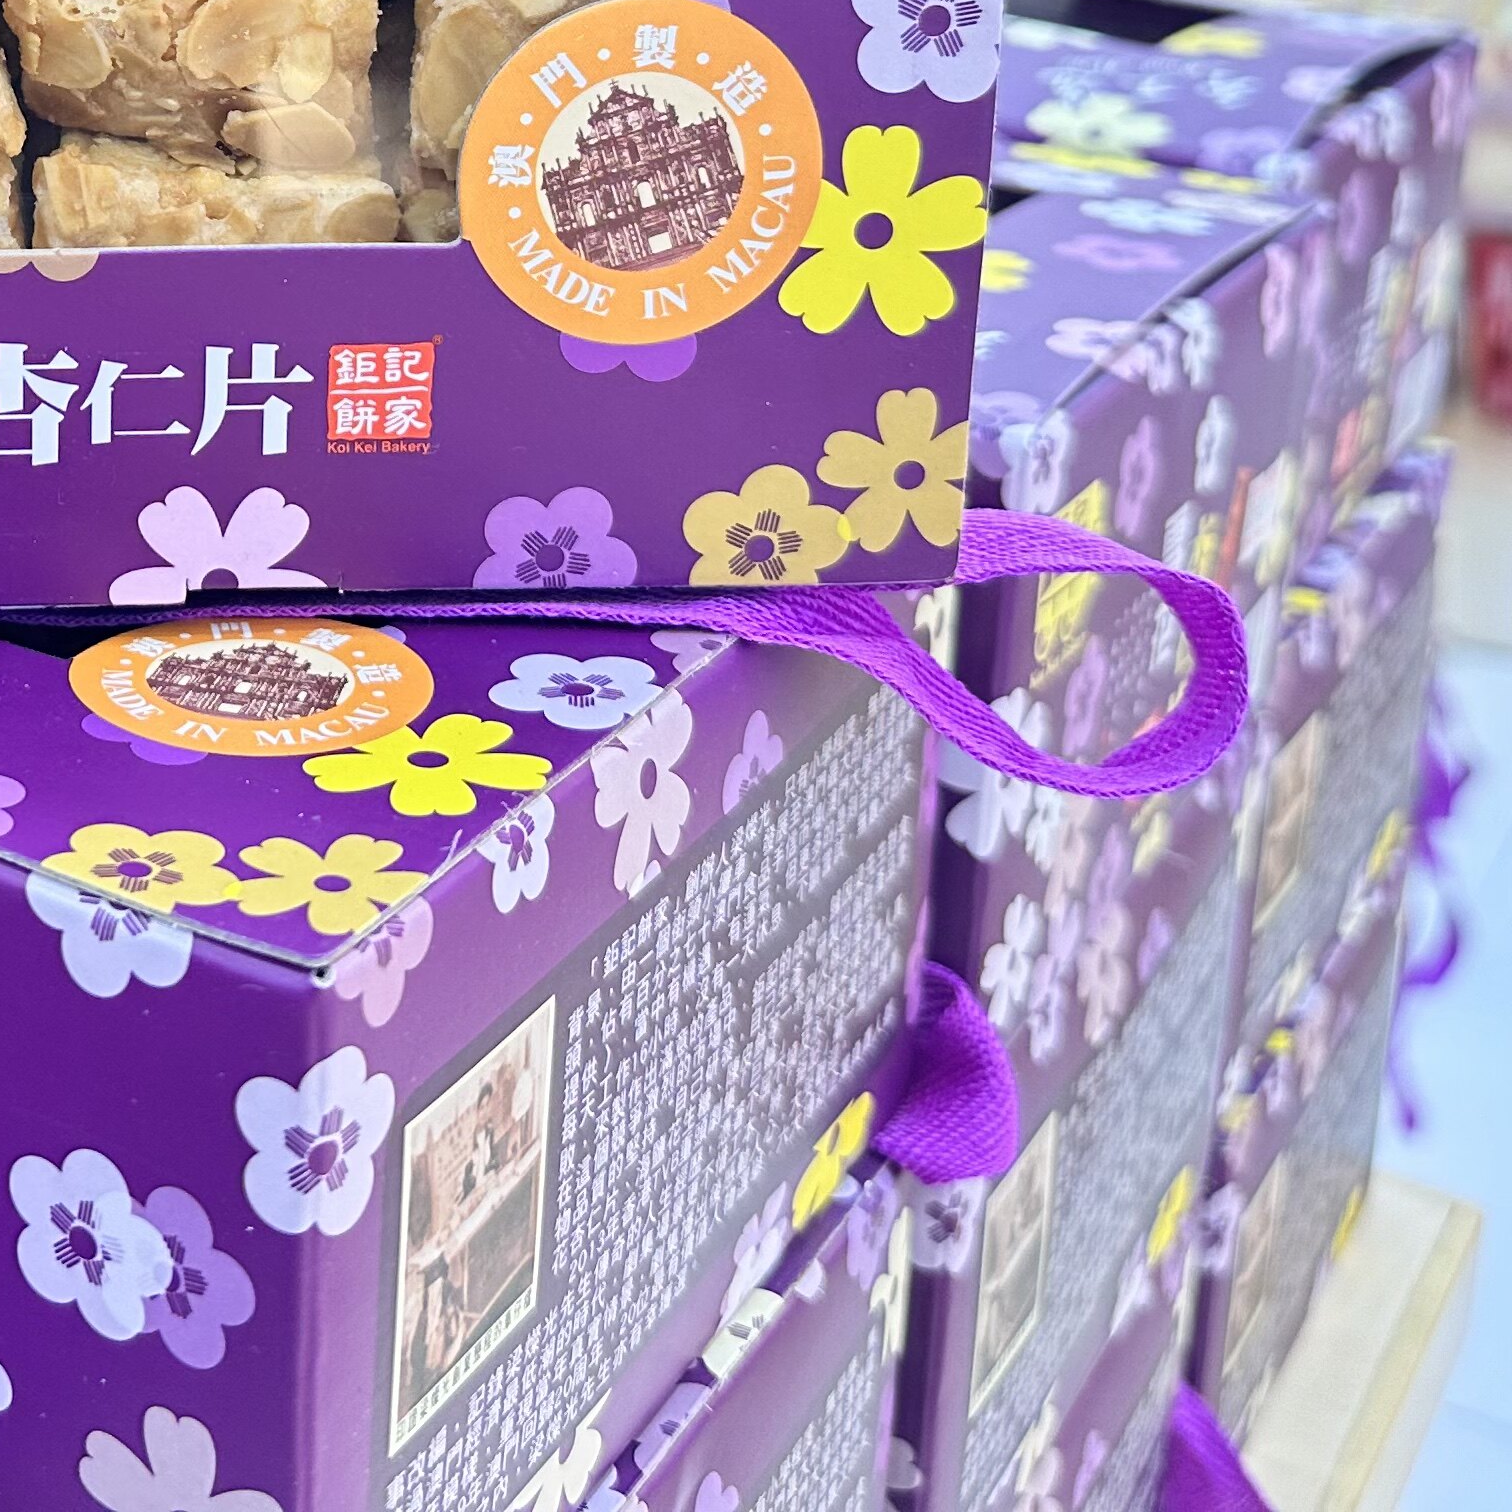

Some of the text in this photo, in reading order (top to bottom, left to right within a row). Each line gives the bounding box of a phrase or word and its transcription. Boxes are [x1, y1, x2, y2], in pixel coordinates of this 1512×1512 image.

[508, 154, 798, 319] MADE IN MACAU
[333, 346, 430, 386] 鉅記
[332, 395, 428, 436] 餅家
[381, 440, 431, 455] Bakery
[101, 667, 390, 747] MADE IN MACAU
